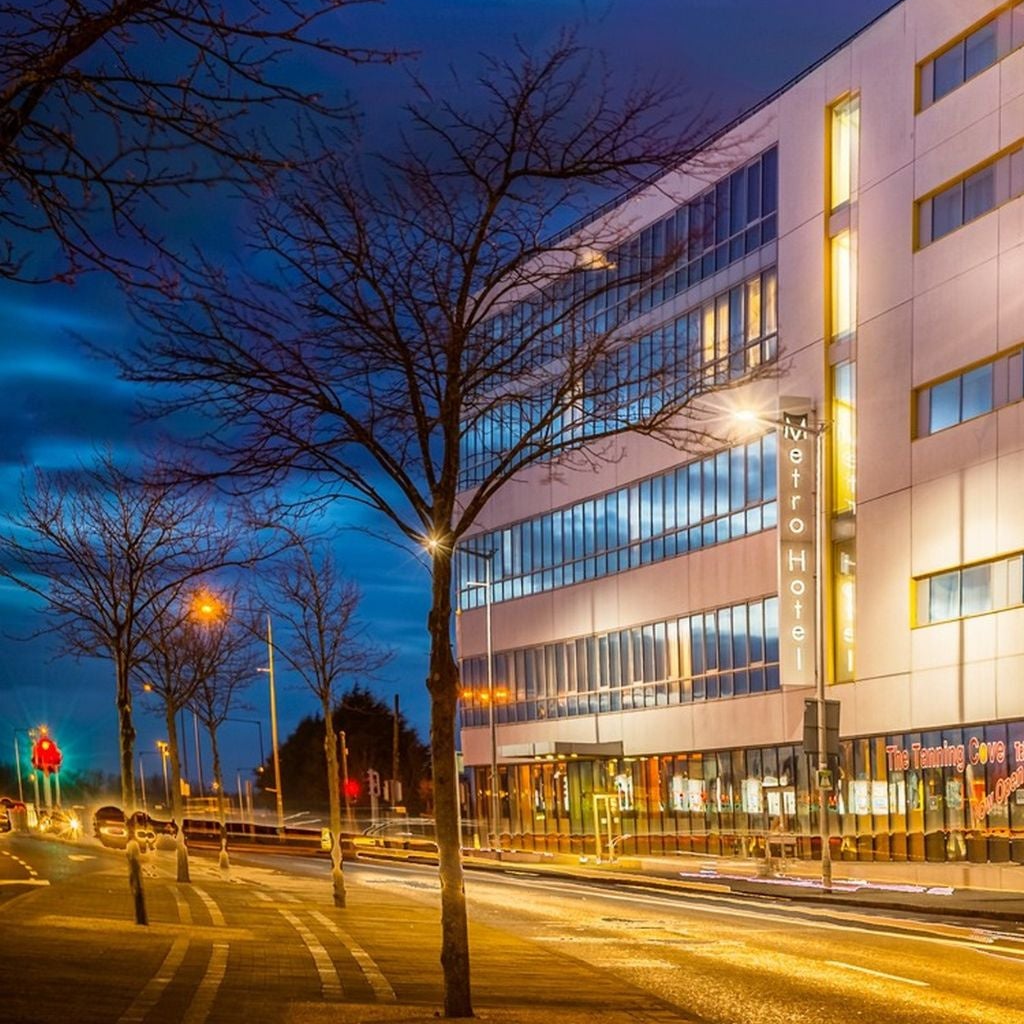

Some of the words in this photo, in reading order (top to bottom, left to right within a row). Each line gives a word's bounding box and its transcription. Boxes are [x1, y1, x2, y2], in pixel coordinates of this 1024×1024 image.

[784, 416, 808, 534] Metro
[788, 549, 806, 671] Hotel
[886, 745, 909, 771] The
[911, 742, 965, 773] Tanning
[968, 736, 1006, 765] Cove
[995, 765, 1024, 805] Open
